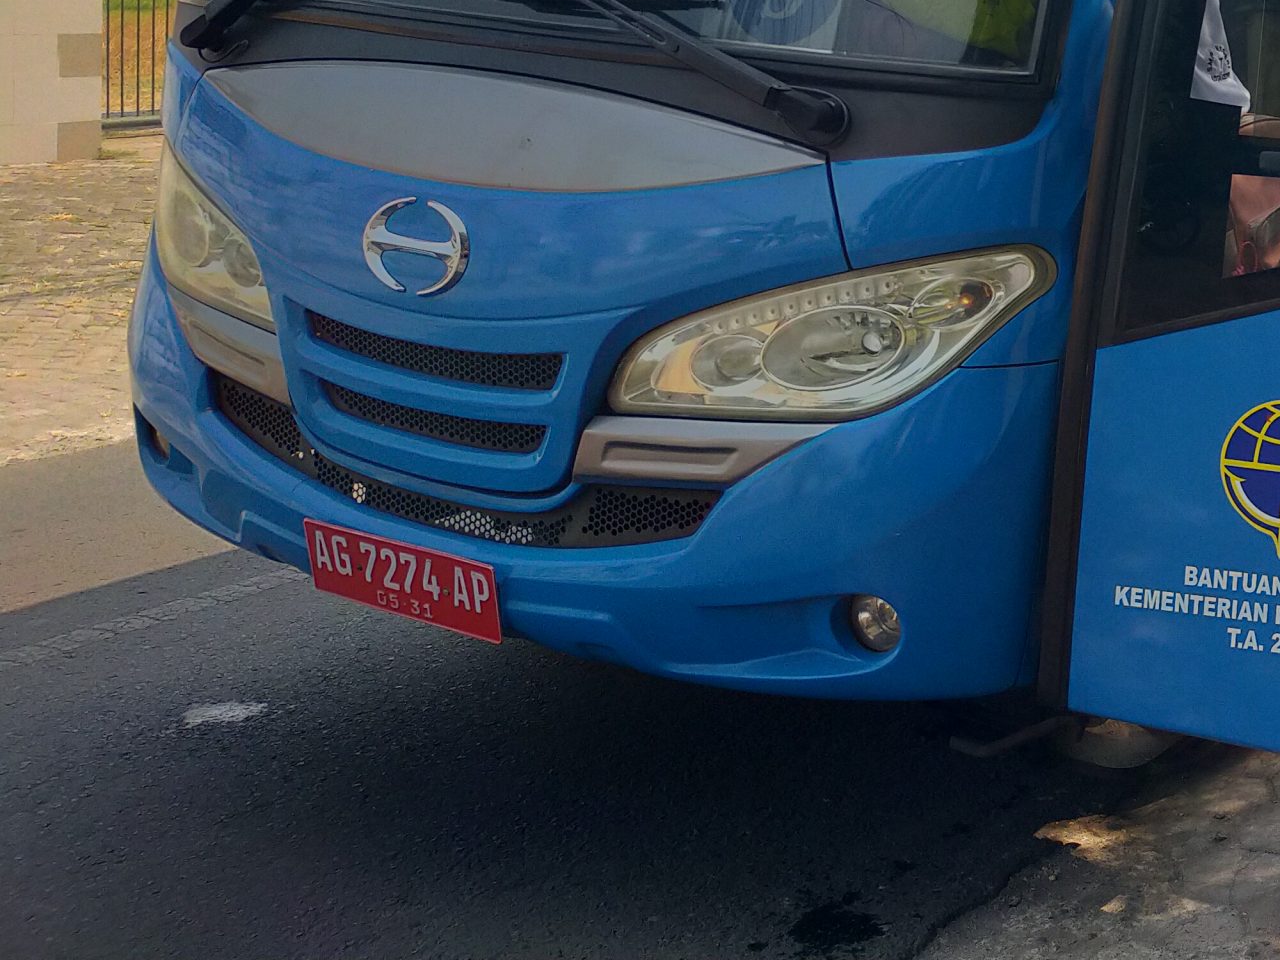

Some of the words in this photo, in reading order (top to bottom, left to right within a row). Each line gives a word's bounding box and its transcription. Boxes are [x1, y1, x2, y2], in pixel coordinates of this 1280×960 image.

[315, 530, 353, 577] AG
[359, 541, 441, 601] 7274
[454, 566, 490, 614] AP
[1114, 585, 1269, 623] KEMENTERIAN
[1227, 627, 1264, 651] T.A.
